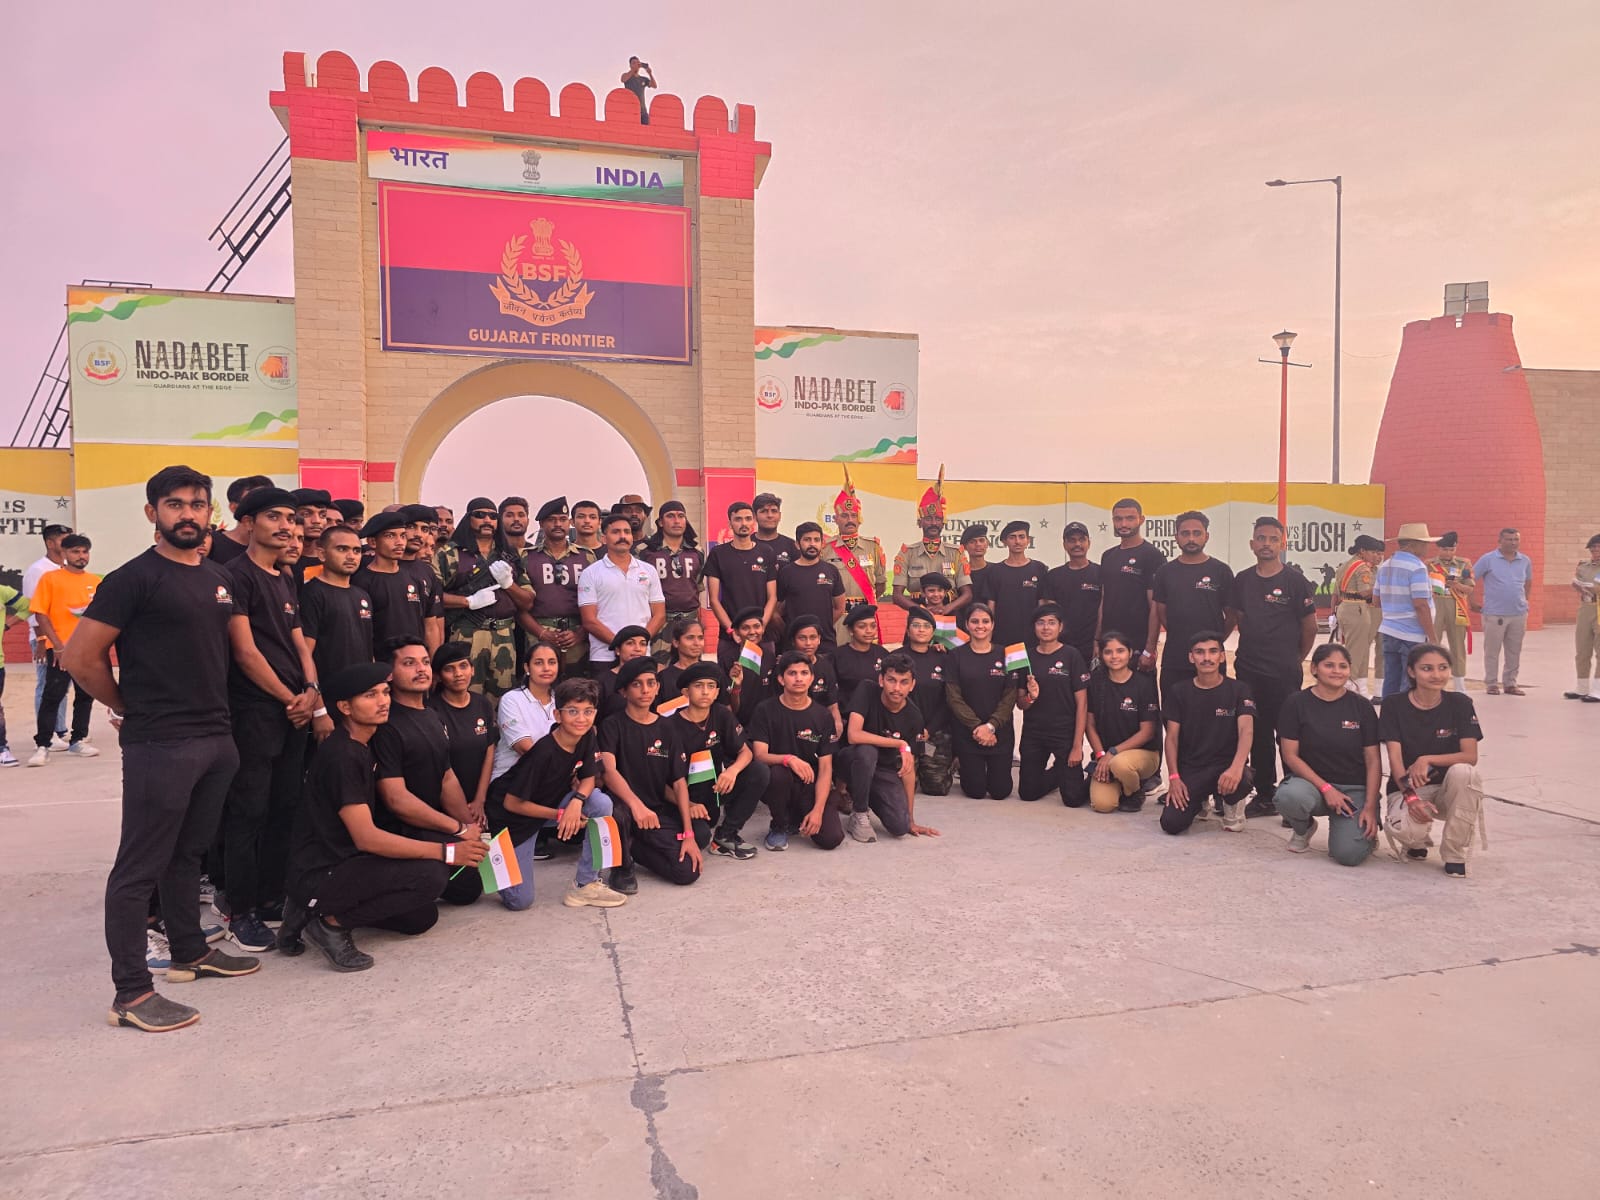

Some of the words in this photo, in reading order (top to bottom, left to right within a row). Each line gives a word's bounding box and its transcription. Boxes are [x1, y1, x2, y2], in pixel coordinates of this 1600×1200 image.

[389, 147, 450, 170] भारत
[596, 166, 664, 190] INDIA
[521, 262, 568, 282] BSF
[468, 328, 538, 345] GUJARAT
[541, 332, 616, 349] FRONTIER
[135, 339, 249, 372] NADABET
[136, 369, 199, 381] INDO-PAK
[202, 371, 249, 382] BORDER
[794, 375, 877, 404] NADABET
[794, 401, 839, 411] INDO-PAK
[841, 403, 876, 413] BORDER
[1145, 519, 1177, 538] PRID
[1294, 521, 1346, 553] JOSH
